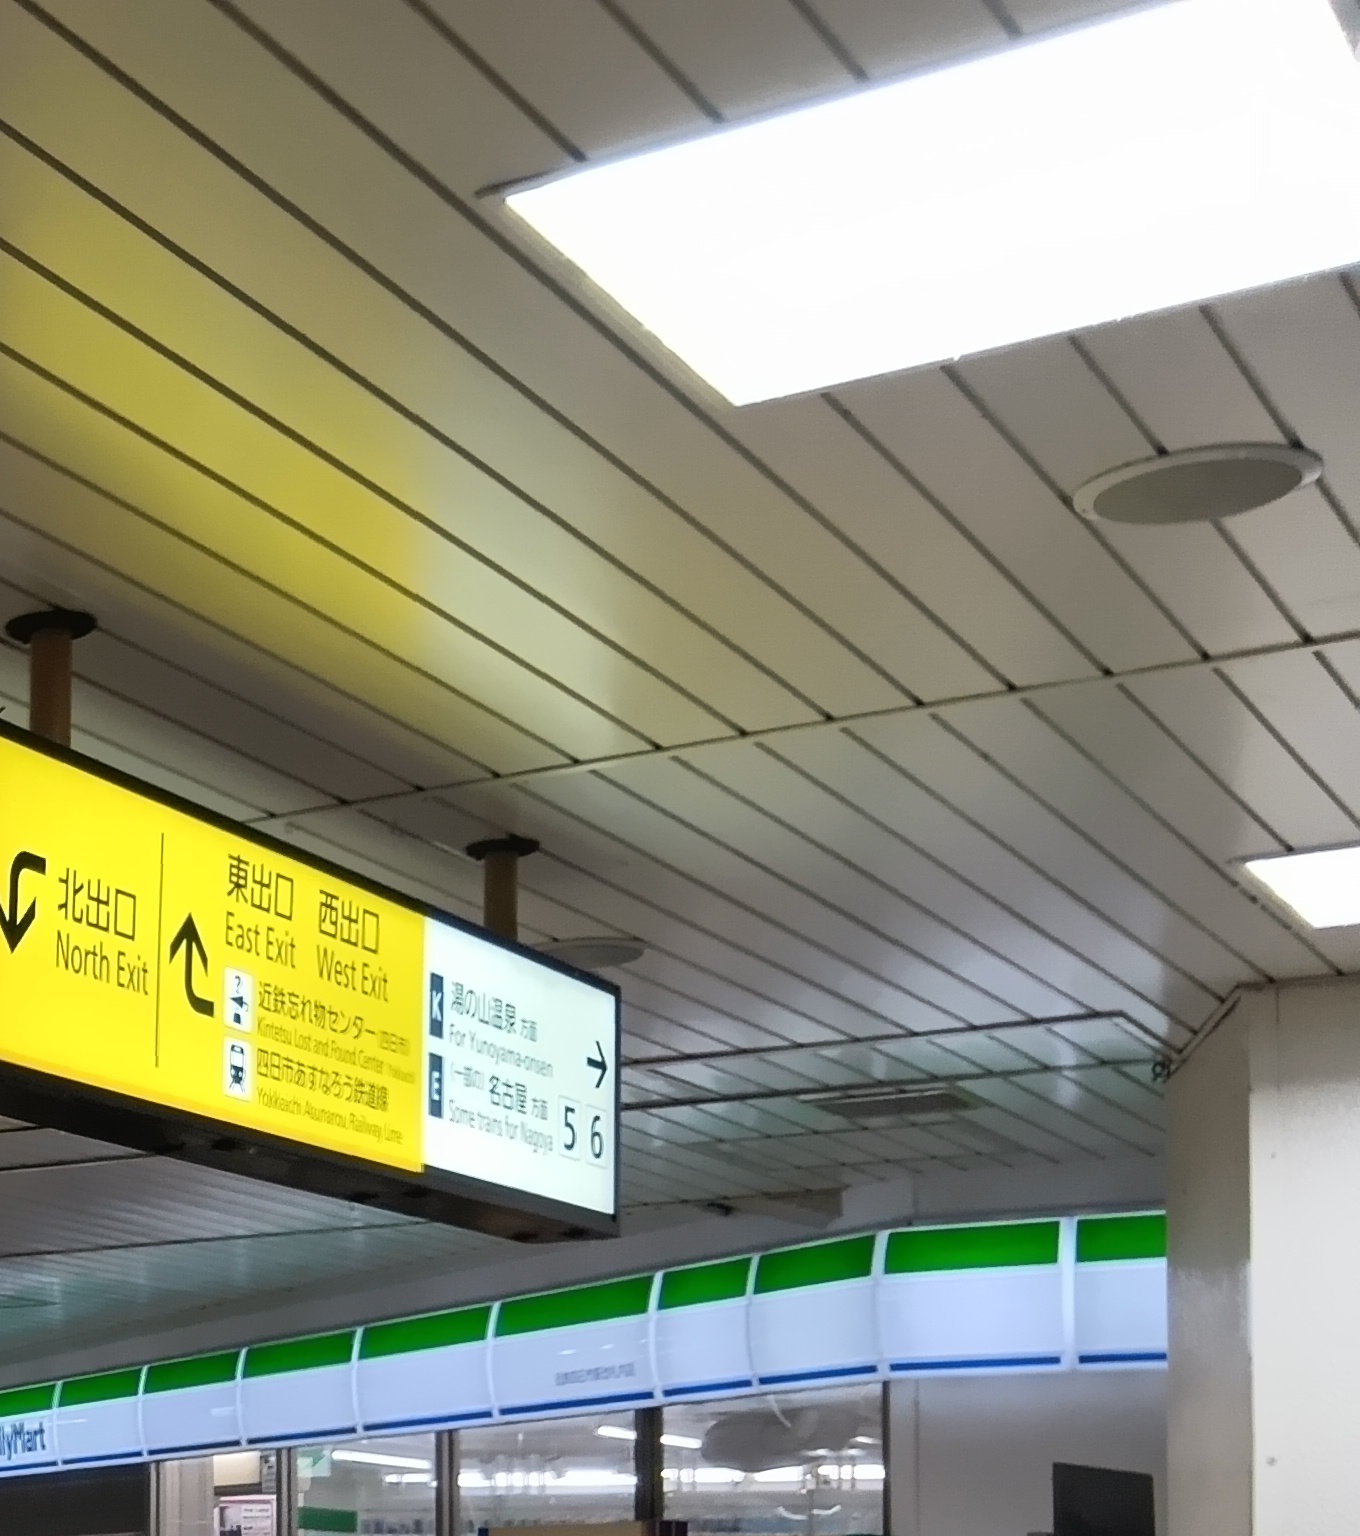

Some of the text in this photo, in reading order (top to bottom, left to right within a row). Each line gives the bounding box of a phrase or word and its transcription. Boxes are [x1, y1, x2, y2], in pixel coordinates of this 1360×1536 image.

[57, 867, 137, 941] 北出口
[226, 854, 380, 954] 東出口 西出口
[56, 929, 149, 996] North Exit
[225, 910, 296, 969] East Exit
[316, 944, 389, 1003] West Exit
[448, 1023, 467, 1047] For
[450, 981, 517, 1034] 湯の山温泉
[256, 1015, 293, 1044] Kintetsu
[293, 1029, 312, 1049] Lost
[313, 1035, 329, 1056] and
[330, 1039, 356, 1065] Found
[358, 1047, 384, 1074] Center
[256, 1047, 390, 1112] 四日市あすなろう鉄道線
[488, 1073, 528, 1115] 名古屋
[448, 1099, 476, 1130] Some
[520, 1121, 554, 1155] Nagoya
[563, 1105, 605, 1159] 5 6
